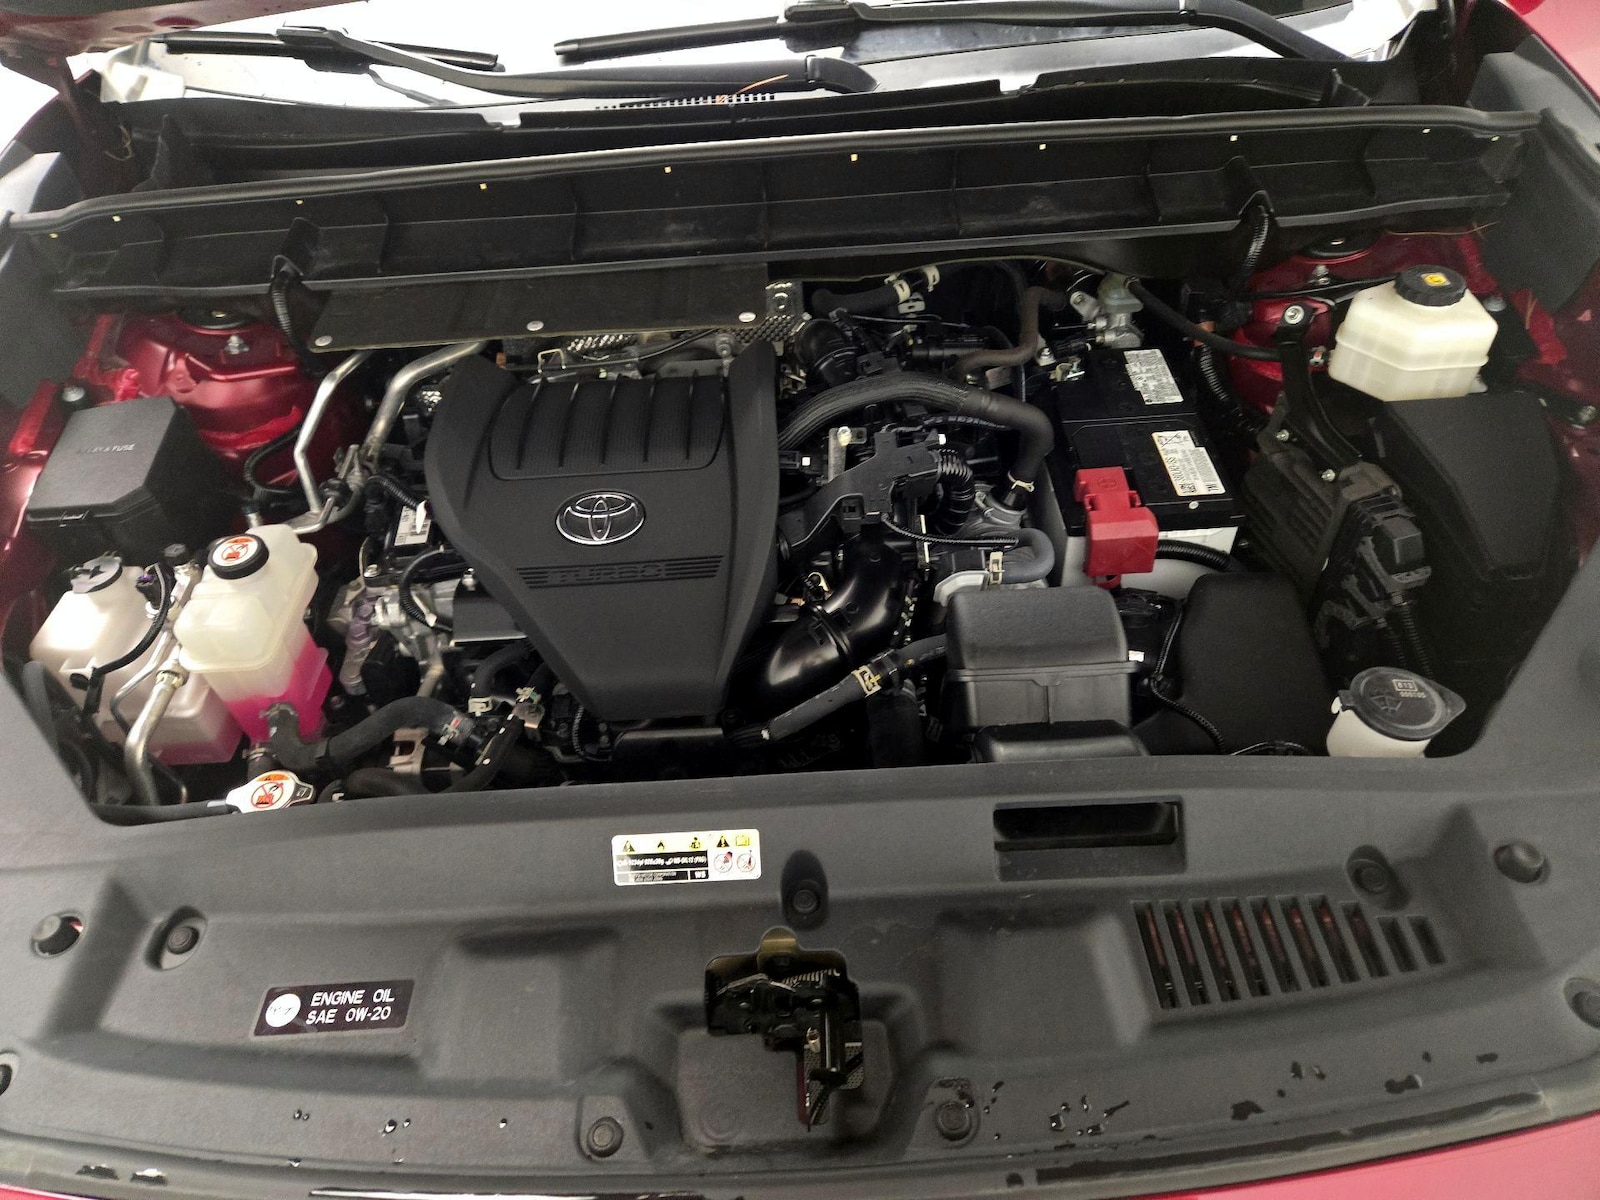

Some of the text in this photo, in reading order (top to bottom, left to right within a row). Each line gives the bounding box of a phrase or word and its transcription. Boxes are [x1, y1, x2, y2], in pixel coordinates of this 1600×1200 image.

[112, 443, 136, 452] FUSE
[551, 563, 662, 582] TURBO
[311, 988, 395, 1007] ENGINE OIL
[306, 1009, 338, 1025] SAE
[345, 1006, 392, 1022] 0W-20
